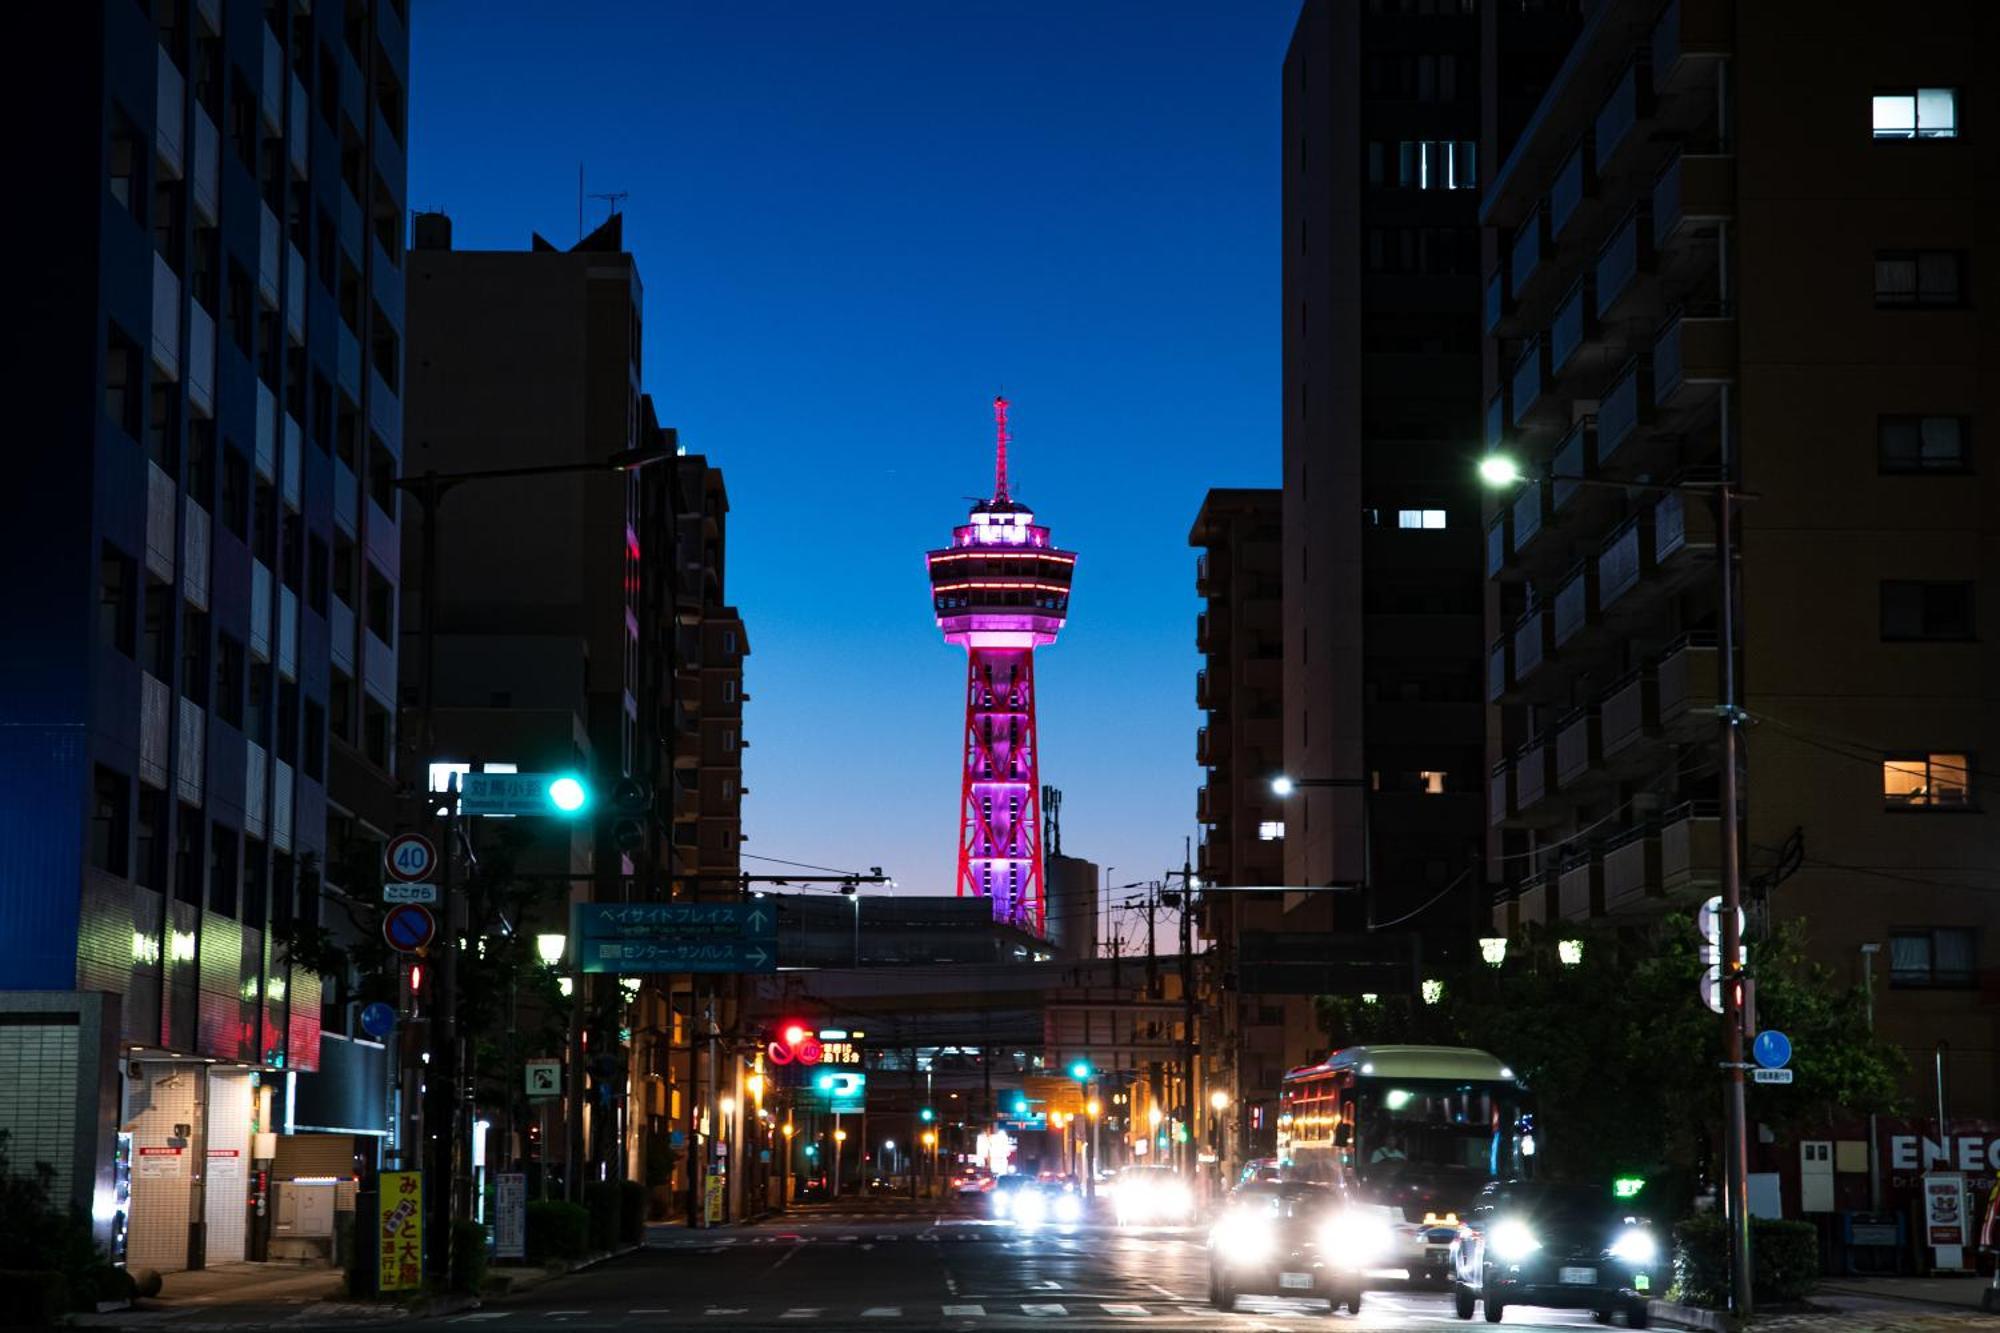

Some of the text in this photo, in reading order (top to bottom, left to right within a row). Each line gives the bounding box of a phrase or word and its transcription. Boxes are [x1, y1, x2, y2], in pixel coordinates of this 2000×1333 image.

[397, 847, 425, 869] 40
[388, 887, 431, 899] ここから
